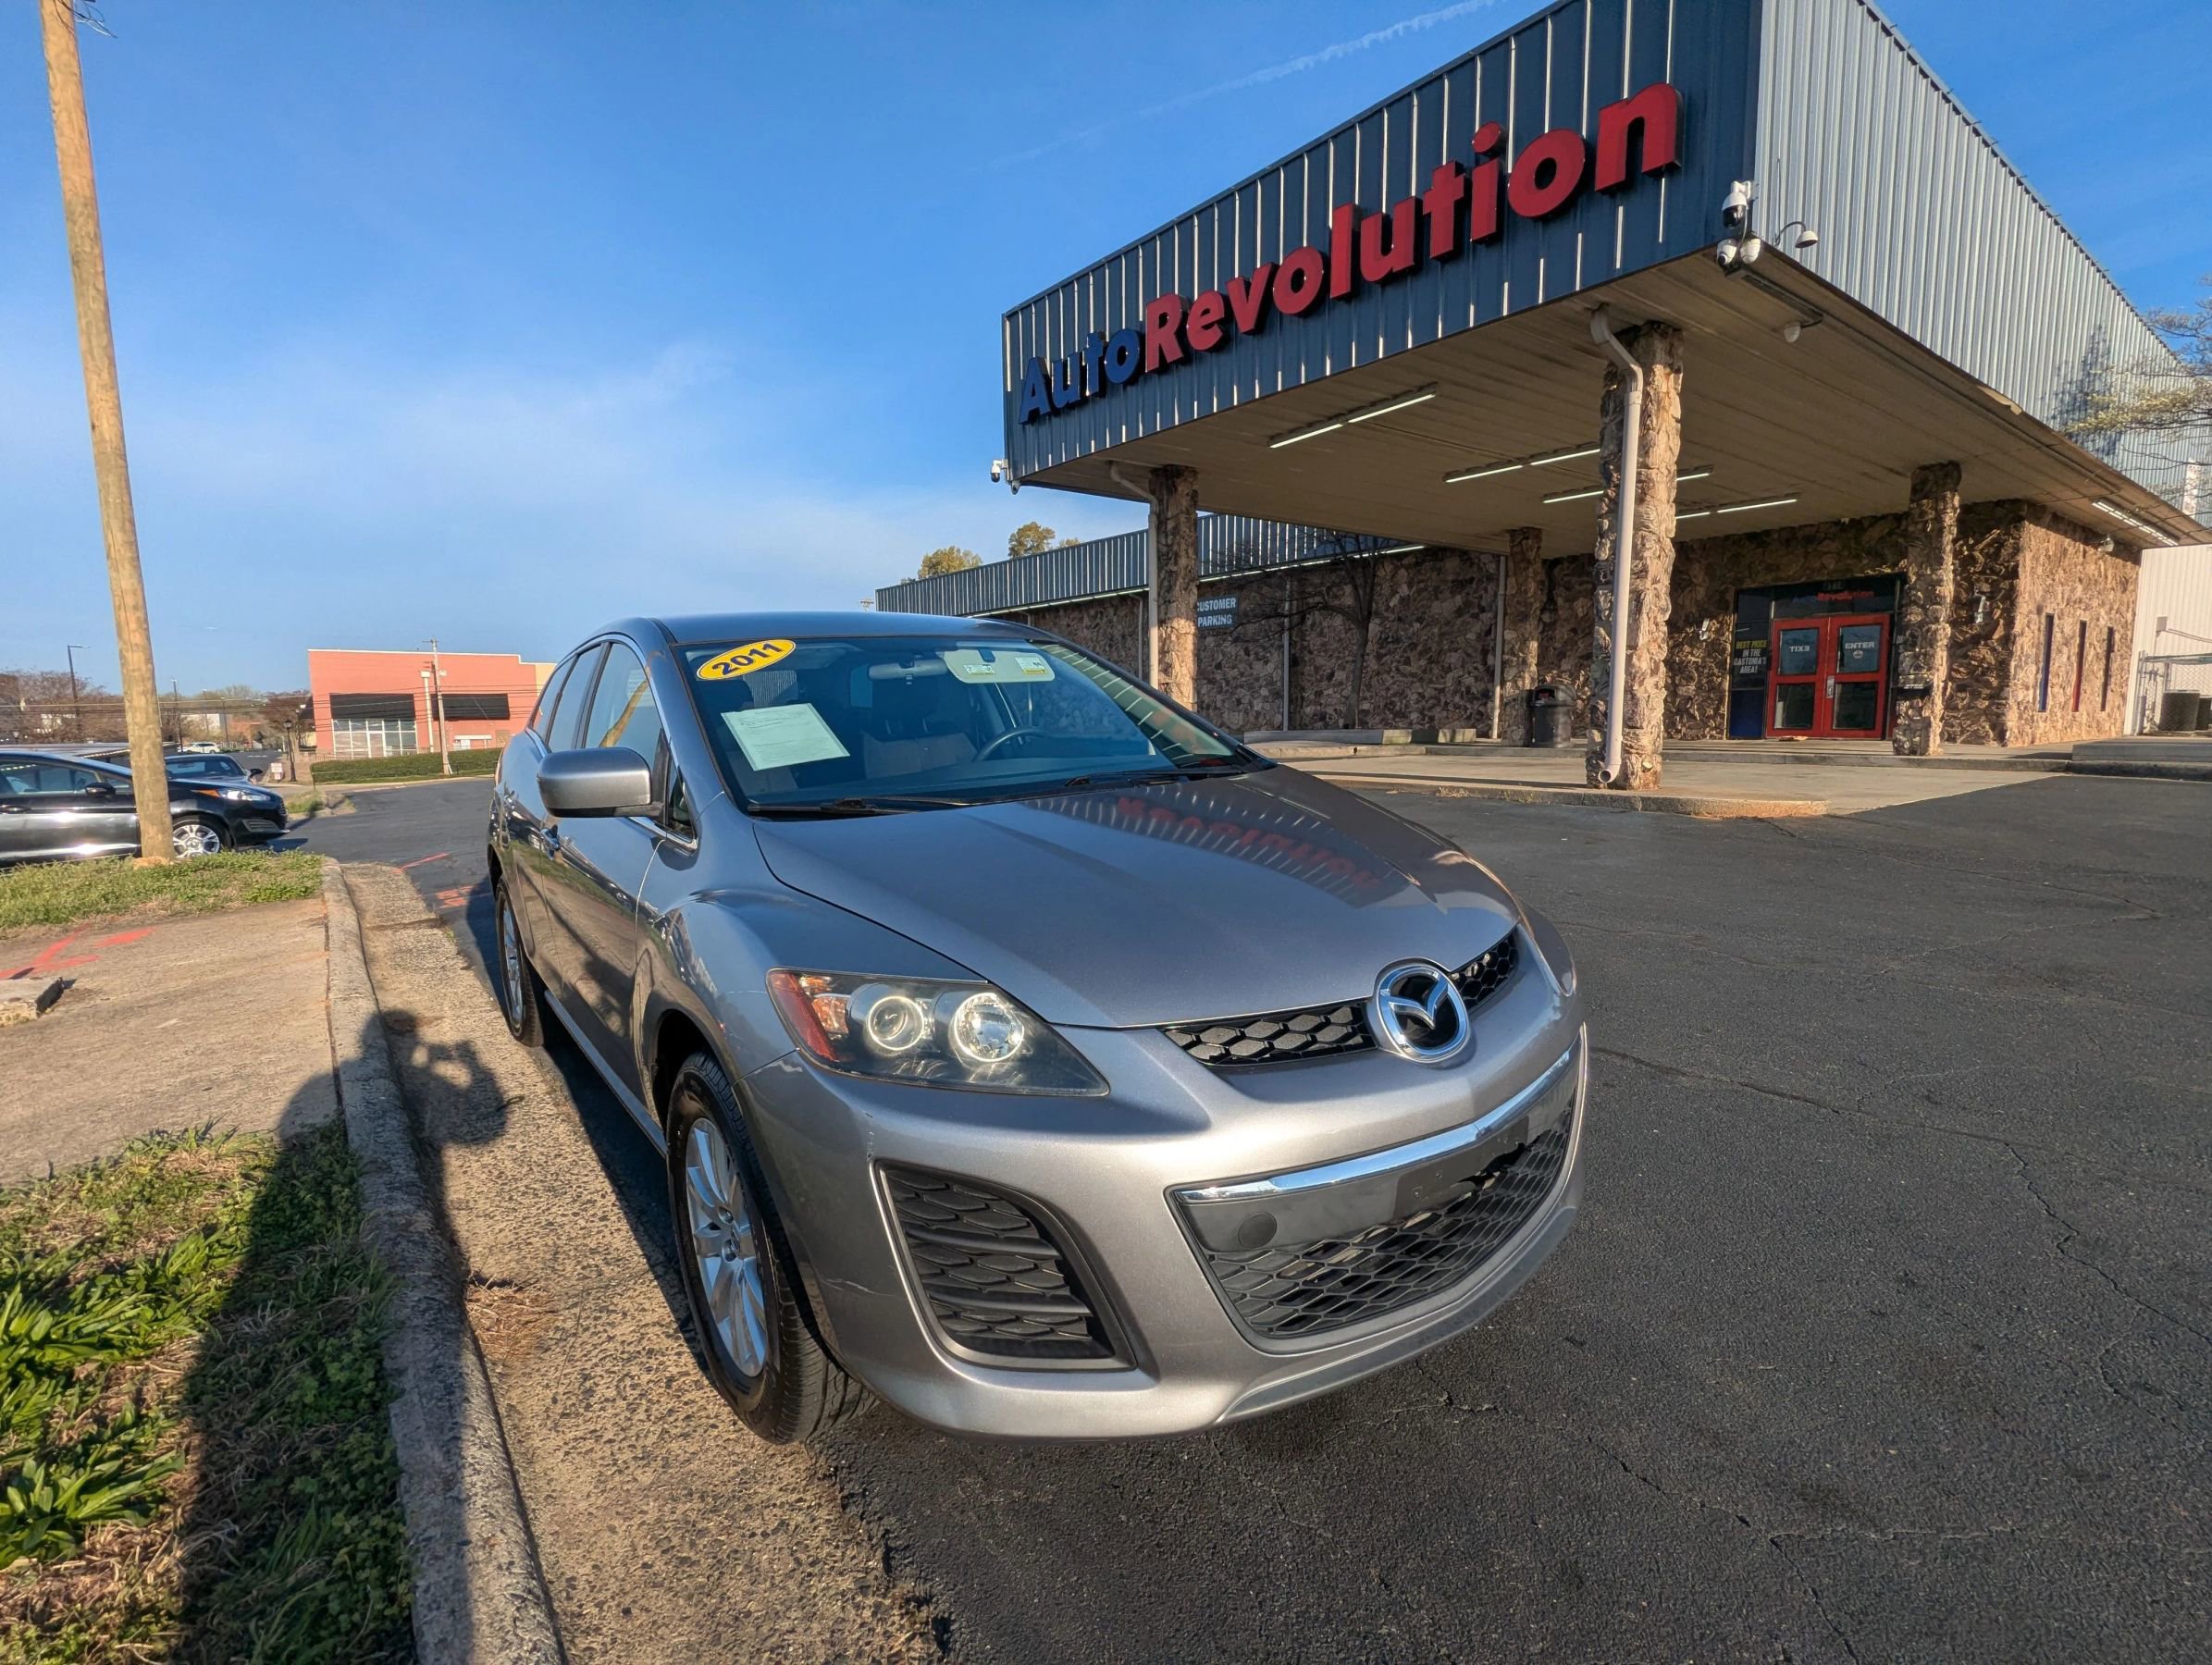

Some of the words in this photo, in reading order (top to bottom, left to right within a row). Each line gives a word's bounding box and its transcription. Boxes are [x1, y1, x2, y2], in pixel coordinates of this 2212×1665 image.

[1019, 82, 1682, 425] AutoRevolution
[1197, 614, 1232, 627] PARKING
[1845, 641, 1875, 649] ENTER
[711, 643, 784, 675] 2011
